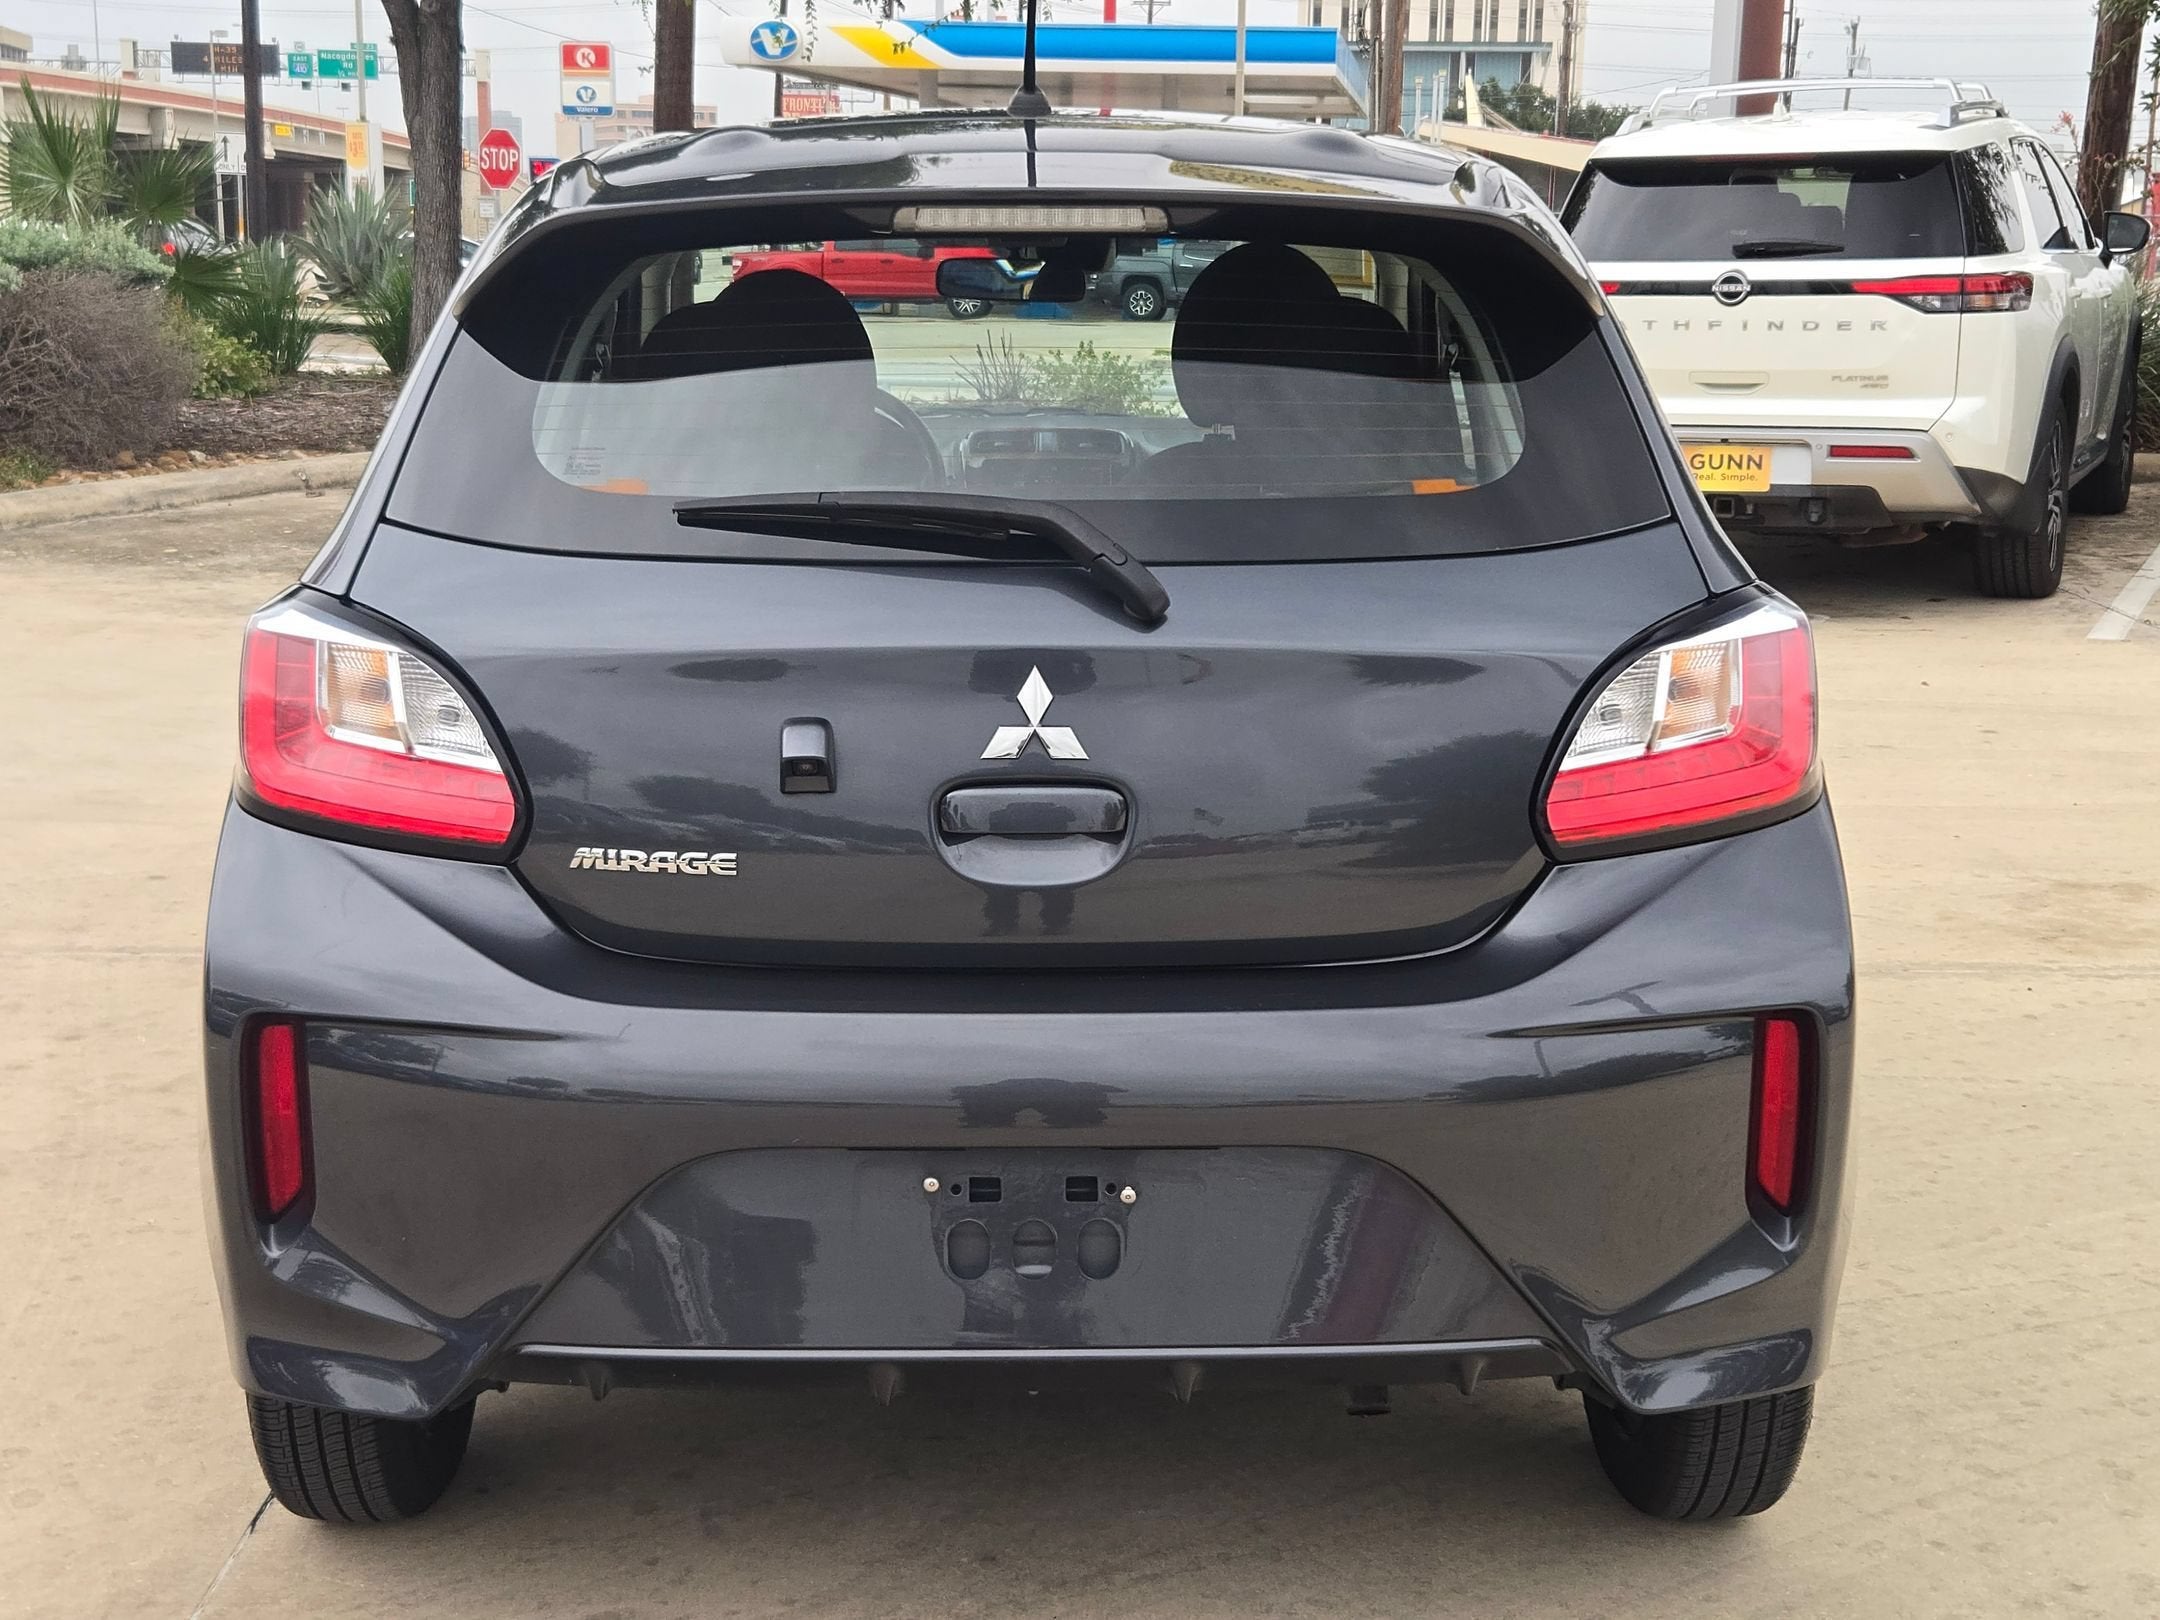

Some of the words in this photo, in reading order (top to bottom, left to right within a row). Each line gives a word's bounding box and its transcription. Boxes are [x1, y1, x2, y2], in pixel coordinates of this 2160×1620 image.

[320, 52, 374, 61] Nacogdoes
[342, 61, 354, 69] Rd
[481, 147, 519, 171] STOP
[1711, 284, 1751, 293] NISSAN
[1690, 453, 1764, 471] GUNN
[1720, 472, 1758, 483] Simple.
[569, 846, 738, 876] MIRAGE
